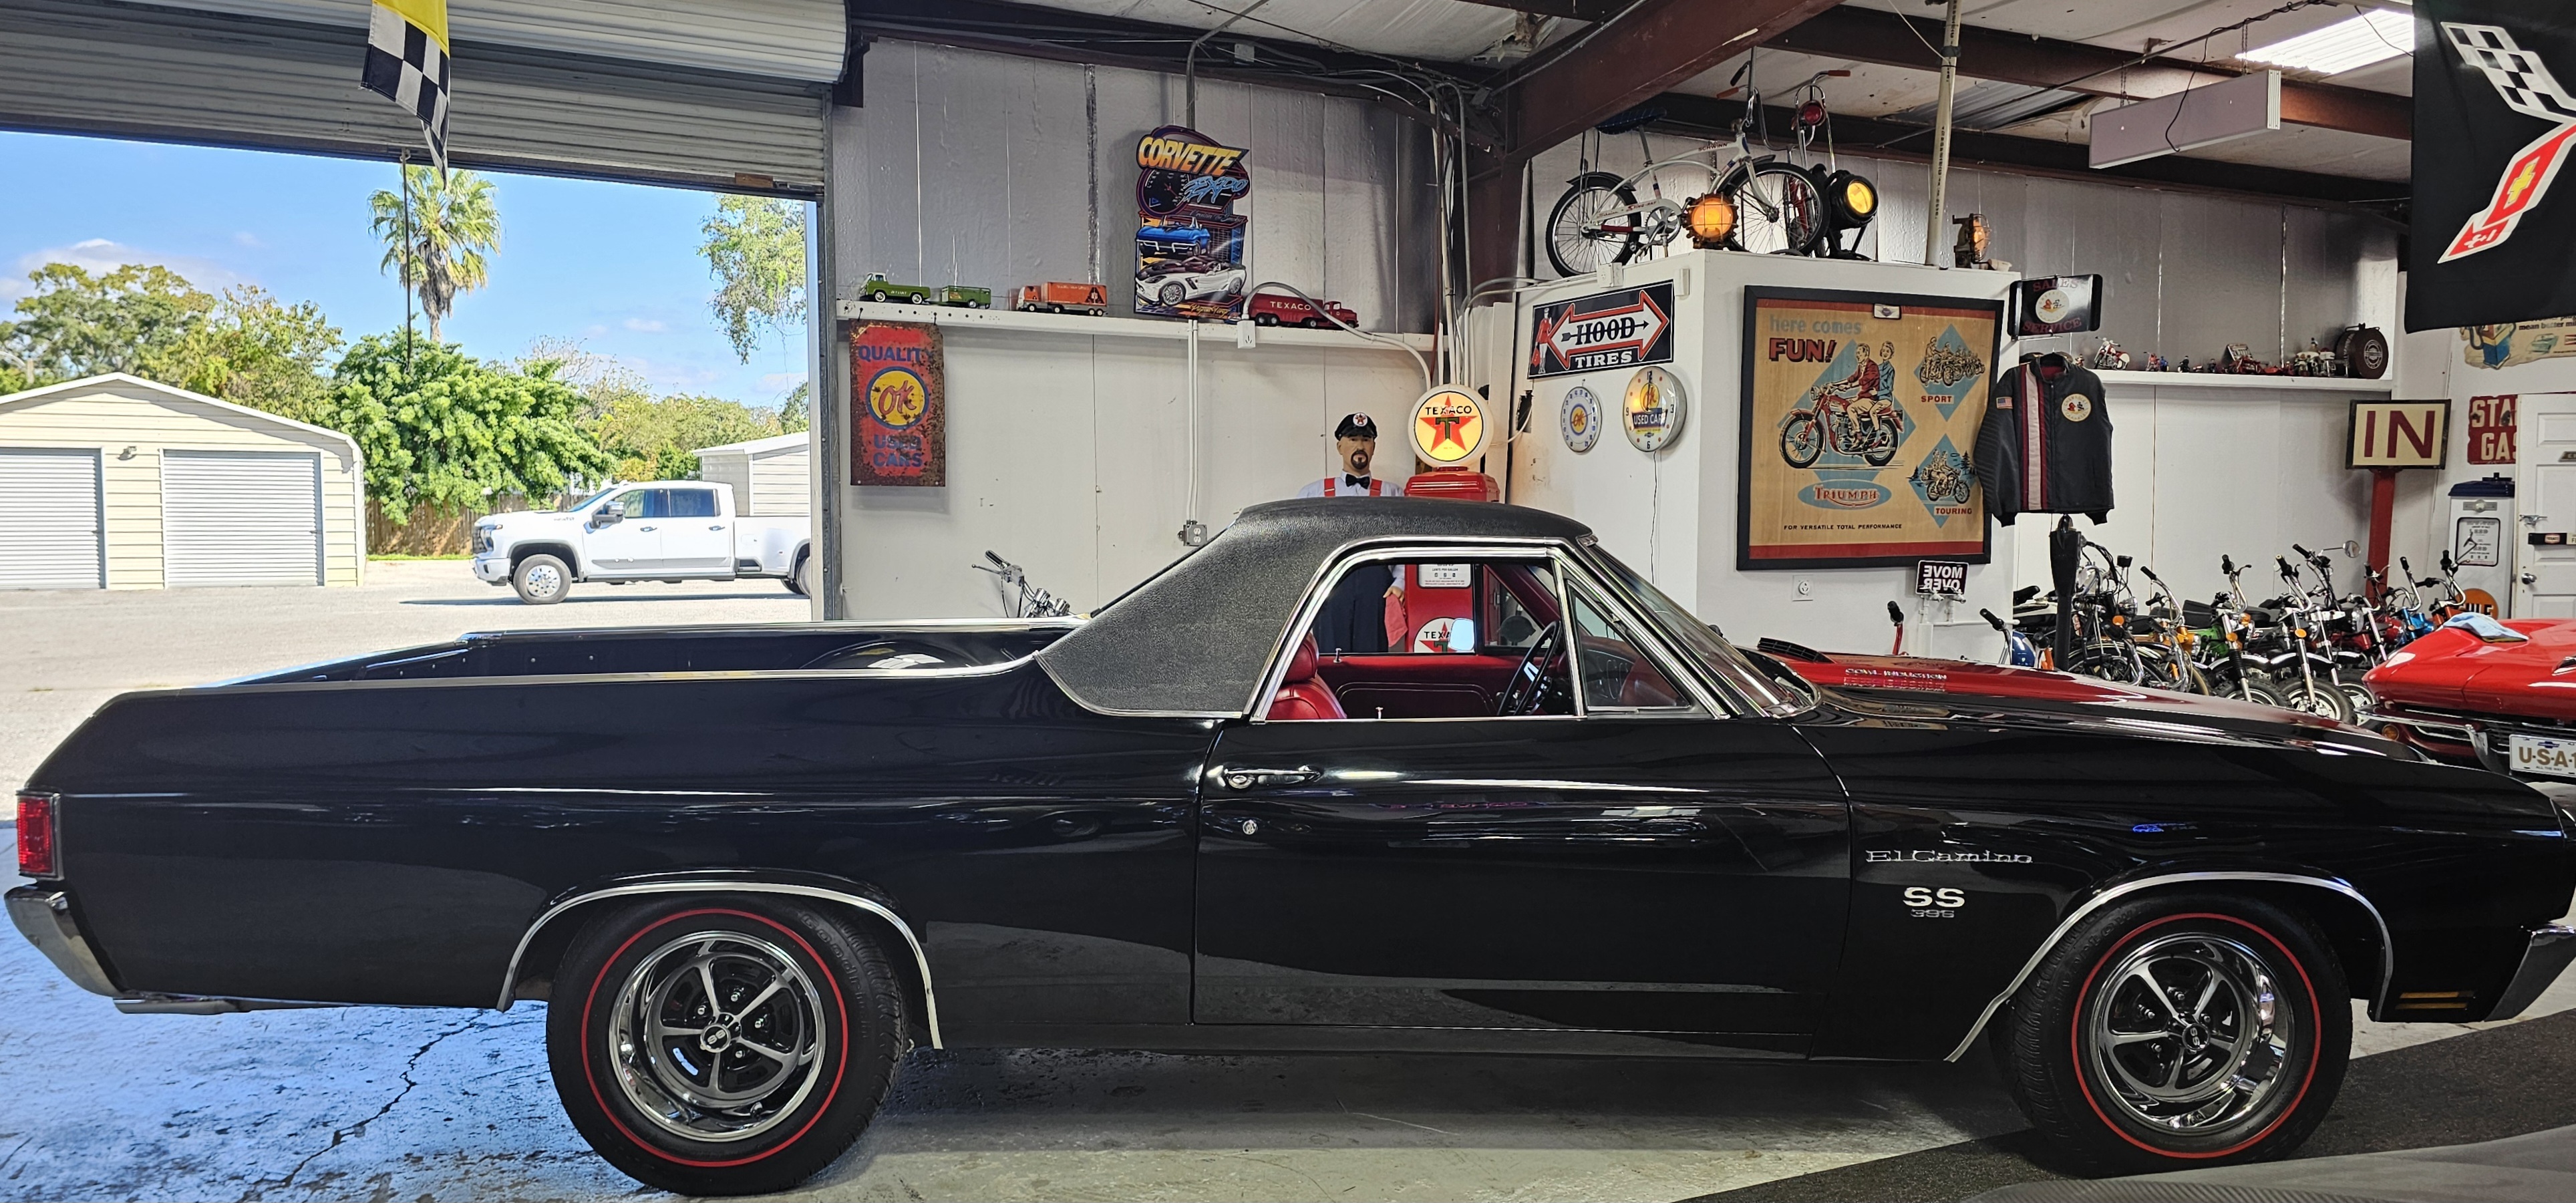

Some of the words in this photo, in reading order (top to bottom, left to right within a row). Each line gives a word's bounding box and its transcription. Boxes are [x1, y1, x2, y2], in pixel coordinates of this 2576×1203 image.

[1698, 142, 1728, 152] SCHWINN
[1138, 136, 1242, 176] CORVETTE
[1183, 176, 1249, 203] EXPO
[2033, 278, 2079, 292] SALES
[1270, 301, 1311, 311] TEXACO
[1575, 317, 1635, 345] HOOD
[1770, 314, 1806, 333] here
[1812, 320, 1862, 335] comes
[2022, 317, 2082, 333] SERVICE
[1769, 337, 1837, 363] FUN!
[1575, 351, 1633, 368] TIRES
[878, 379, 917, 415] OK
[1425, 405, 1472, 415] TEXACO
[1625, 407, 1629, 416] 9
[1670, 404, 1674, 413] 3
[2471, 398, 2518, 427] STA
[1633, 414, 1649, 425] USED
[873, 434, 922, 450] USED
[2364, 410, 2436, 459] IN
[1647, 441, 1651, 450] 6
[872, 452, 923, 468] CARS
[1813, 485, 1879, 503] TRIUMPH
[1424, 631, 1450, 639] TEXA
[1911, 850, 2033, 863] Camino
[1903, 886, 1965, 907] SS
[1911, 908, 1955, 918] 396
[707, 1029, 726, 1045] SS
